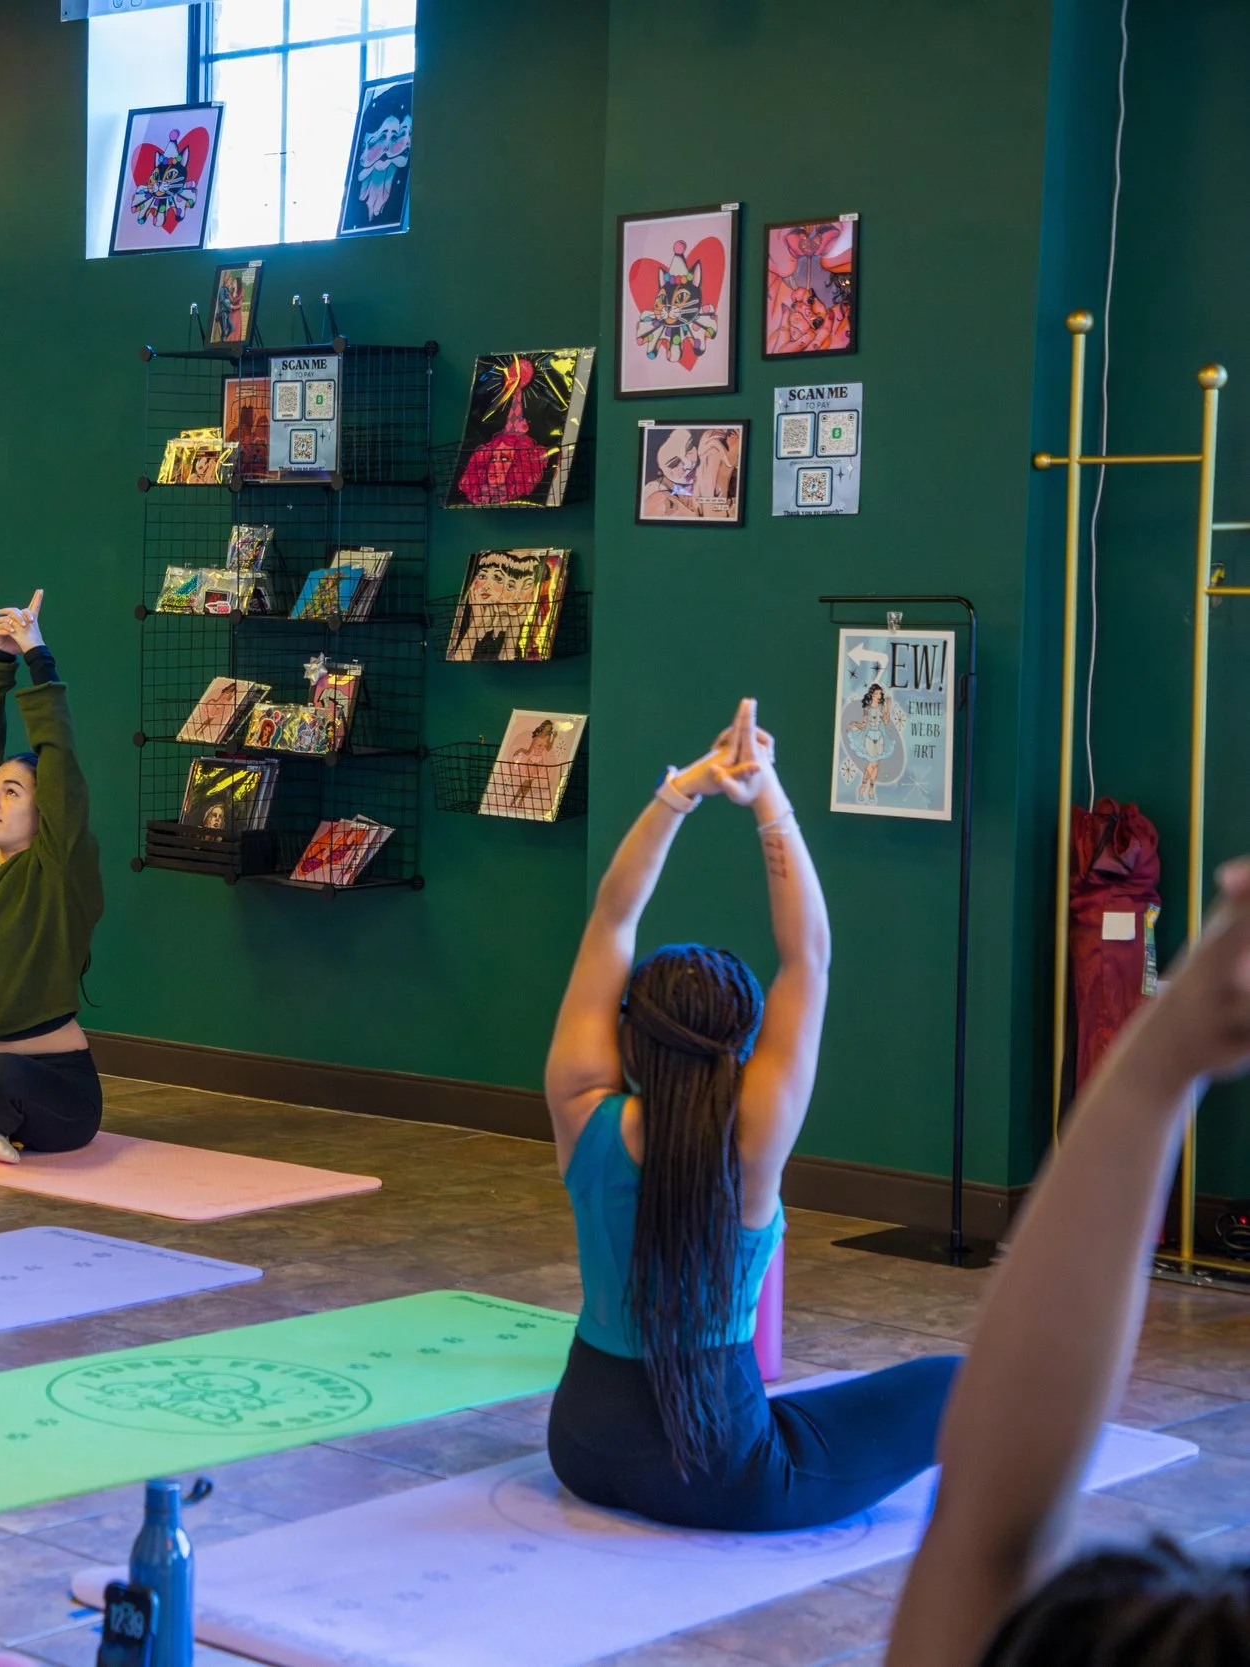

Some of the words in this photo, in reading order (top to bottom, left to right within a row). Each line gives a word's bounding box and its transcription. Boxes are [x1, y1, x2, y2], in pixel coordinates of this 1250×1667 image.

[281, 360, 309, 370] SCAN
[311, 359, 327, 369] ME
[788, 388, 825, 401] SCAN
[827, 386, 848, 398] ME
[817, 401, 831, 409] PAY
[888, 640, 948, 692] EW!
[908, 701, 944, 716] EMMIE
[911, 723, 941, 737] WEBB
[914, 745, 937, 759] ART
